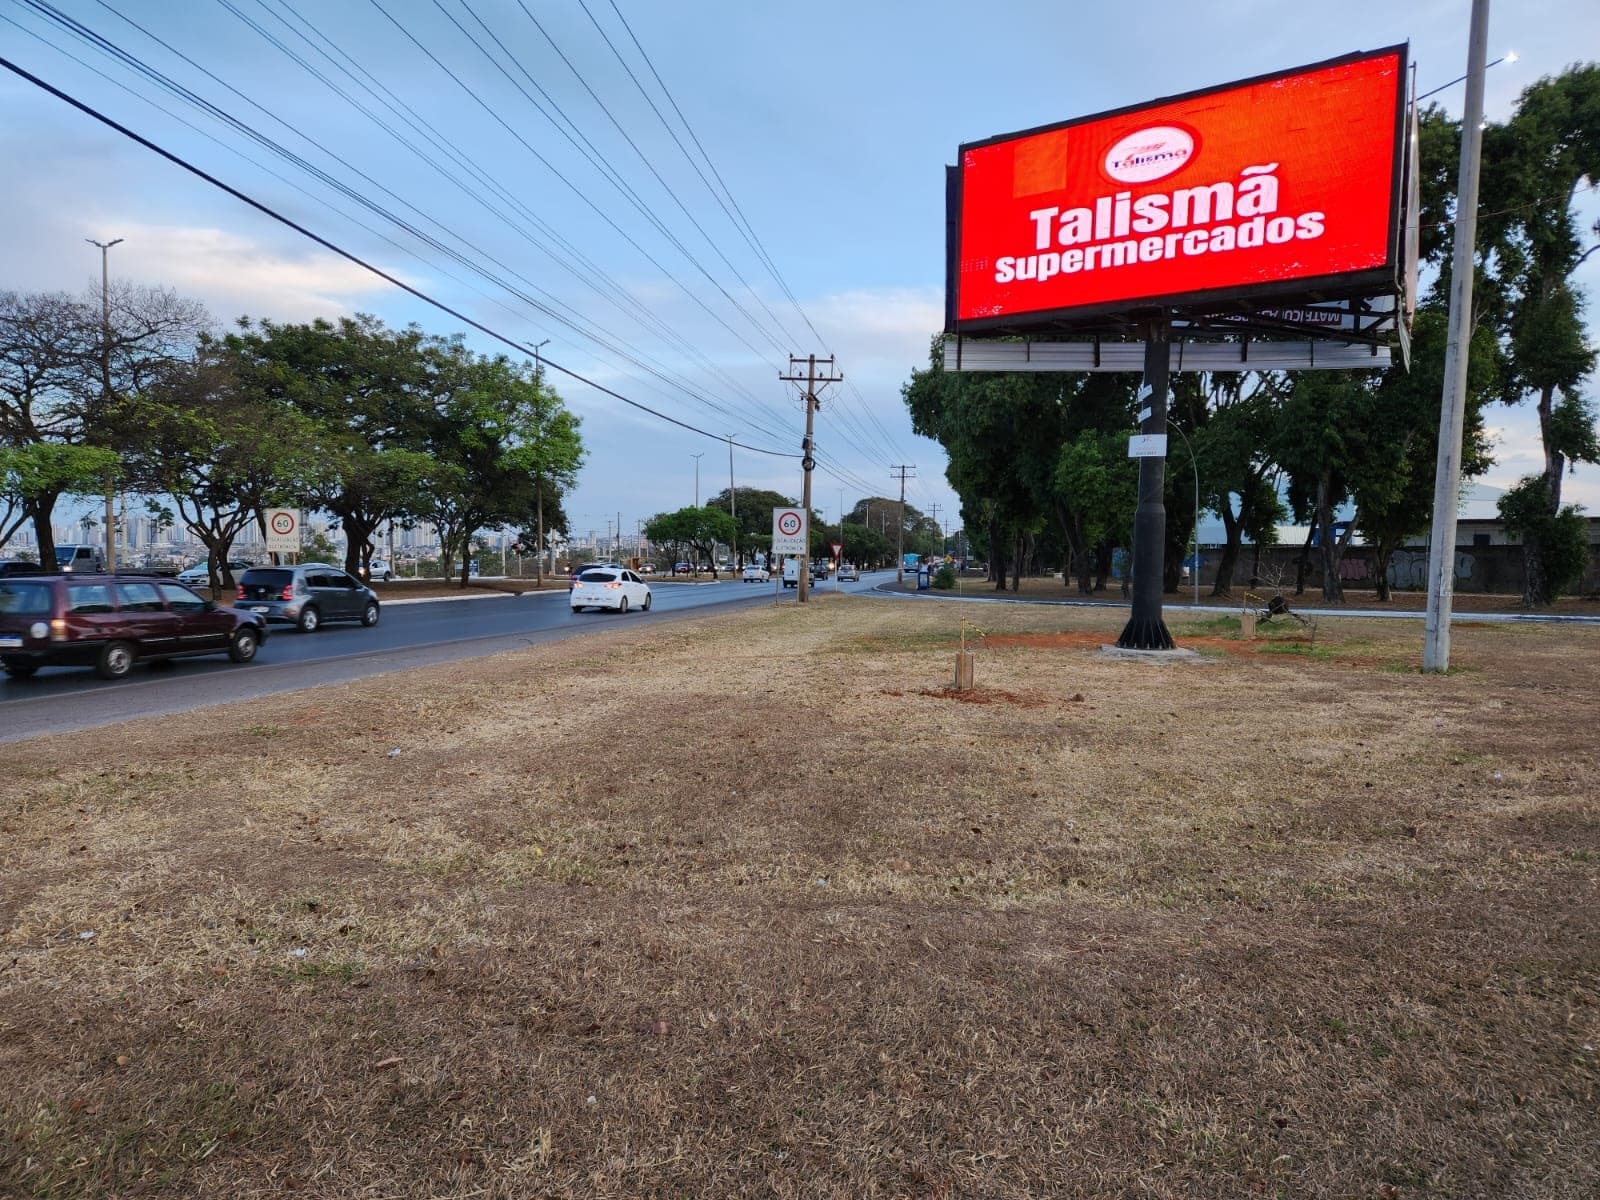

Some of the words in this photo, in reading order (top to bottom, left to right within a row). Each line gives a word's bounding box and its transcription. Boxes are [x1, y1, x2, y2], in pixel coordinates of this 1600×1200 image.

[1030, 163, 1279, 250] Talismã
[277, 519, 289, 528] 60
[784, 519, 795, 528] 60
